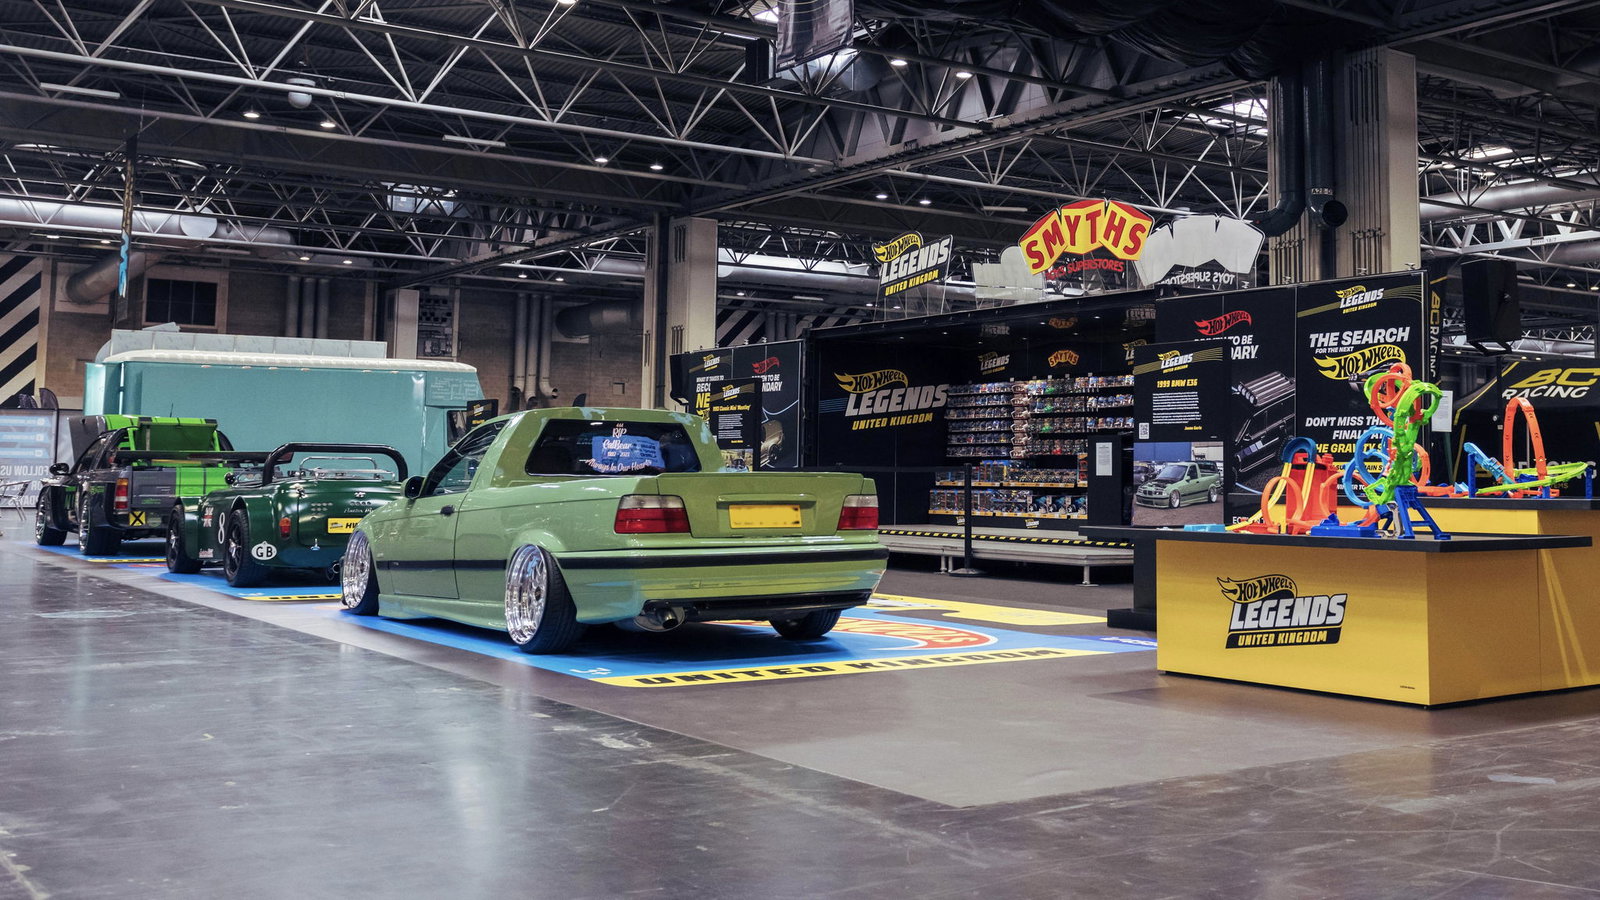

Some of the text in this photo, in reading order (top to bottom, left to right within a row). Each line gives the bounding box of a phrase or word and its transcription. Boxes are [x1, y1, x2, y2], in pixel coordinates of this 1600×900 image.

[1026, 209, 1147, 270] SMYTHS
[881, 238, 951, 284] LEGENDS
[1067, 258, 1124, 273] SUPERSTORES
[885, 269, 939, 296] UNITED KINGDOM
[1340, 288, 1384, 308] LEGENDS
[1430, 290, 1440, 325] BC
[1241, 335, 1253, 345] BE
[1309, 327, 1411, 347] THE SEARCH
[980, 354, 1010, 370] LEGENDS
[1049, 351, 1078, 366] SMYTHS
[1161, 353, 1193, 369] LEGENDS
[1508, 367, 1600, 389] BC
[845, 384, 949, 416] LEGENDS
[1502, 385, 1590, 400] RACING
[852, 412, 934, 430] UNITED KINGDOM
[1305, 417, 1335, 427] DON'T
[1337, 416, 1364, 426] MISS
[1314, 444, 1329, 453] HE
[217, 512, 226, 544] 8
[256, 546, 273, 558] GB
[1230, 594, 1348, 629] LEGENDS
[1238, 630, 1328, 647] UNITED KINGDOM
[634, 649, 1066, 685] UNITED KINGDOM
